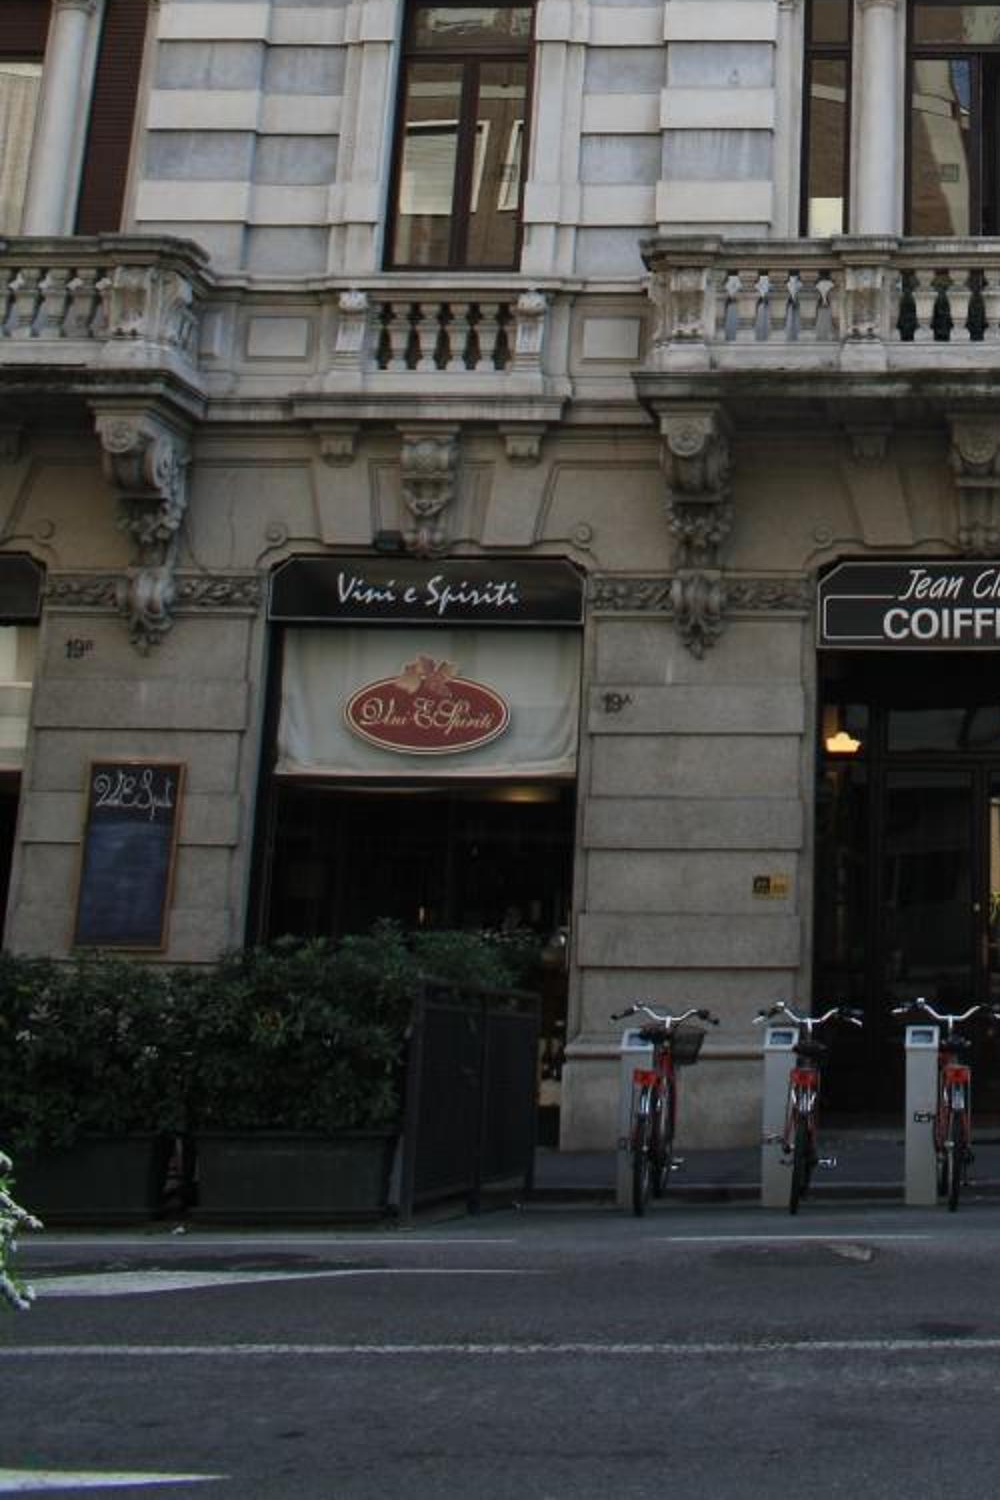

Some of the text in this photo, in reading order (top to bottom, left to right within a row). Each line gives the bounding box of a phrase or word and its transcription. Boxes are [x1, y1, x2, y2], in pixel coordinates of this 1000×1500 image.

[337, 571, 520, 616] Vini e Spiriti
[897, 568, 964, 601] Jean
